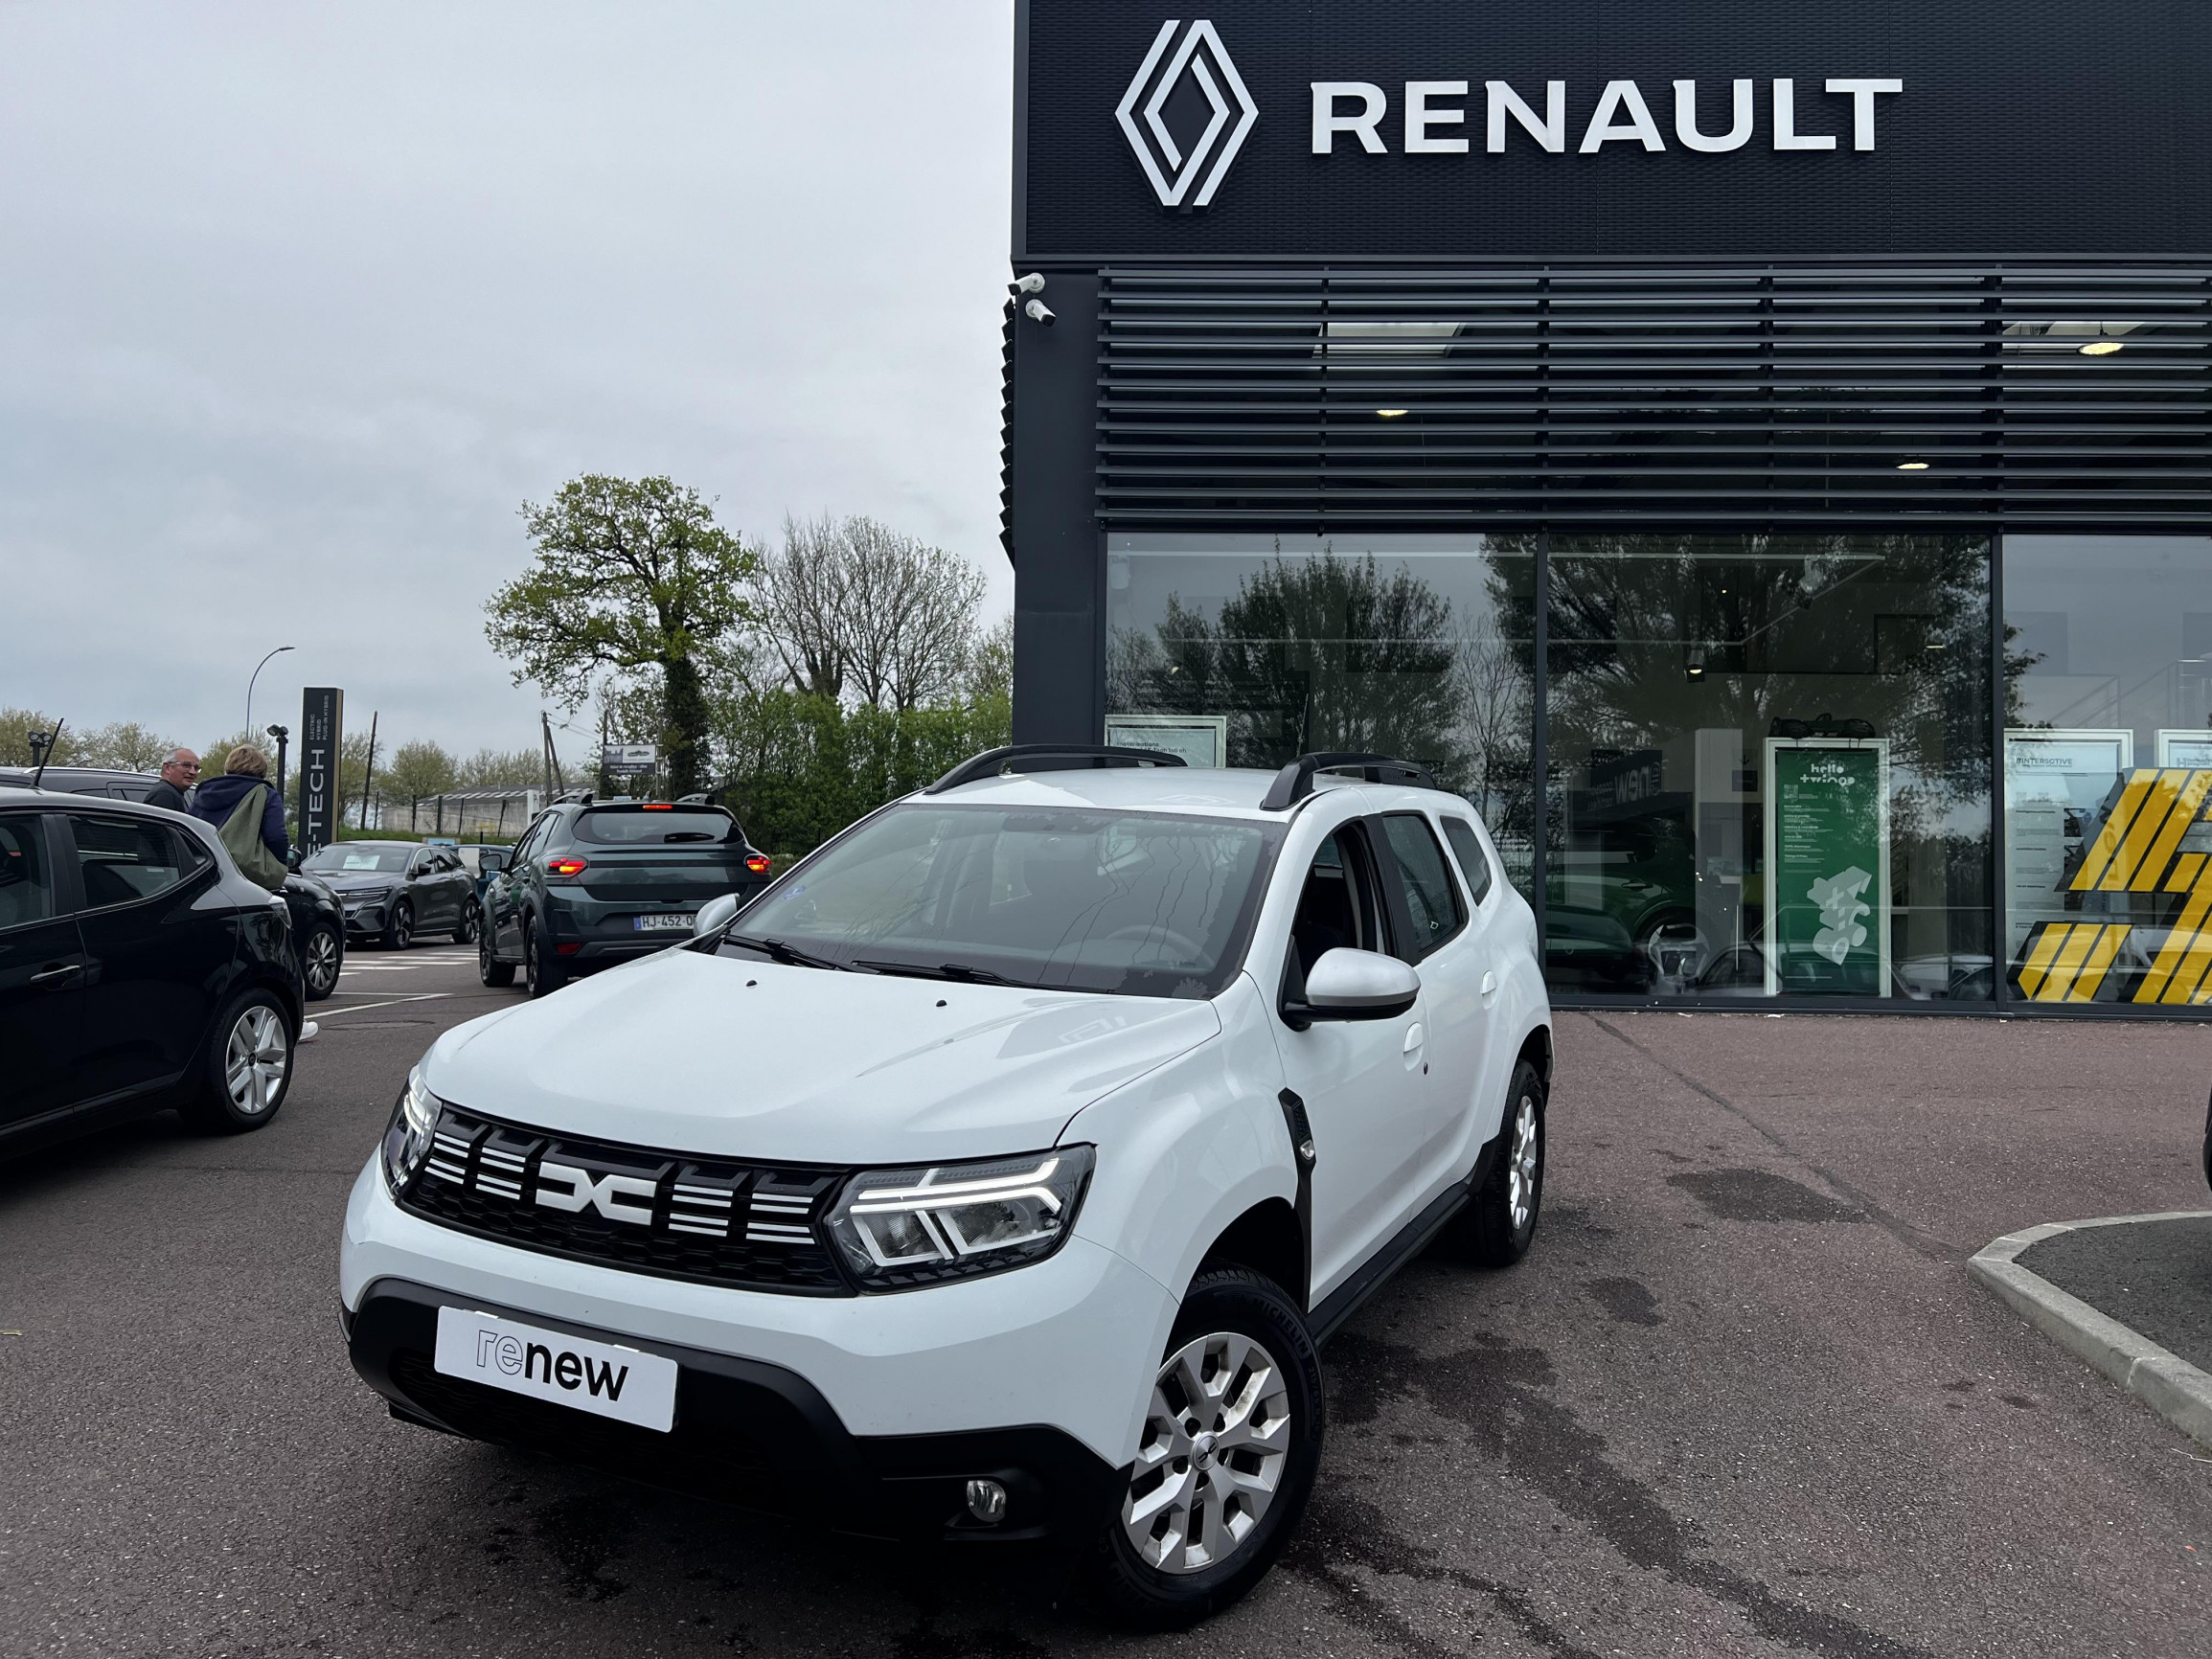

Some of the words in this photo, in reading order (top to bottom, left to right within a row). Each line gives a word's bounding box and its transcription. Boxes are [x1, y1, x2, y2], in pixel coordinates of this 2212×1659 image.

[1311, 78, 1904, 153] RENAULT
[307, 749, 326, 858] E-TECH
[1811, 763, 1844, 774] hello
[1252, 1297, 1310, 1355] MICHELIN
[476, 1329, 629, 1402] renew
